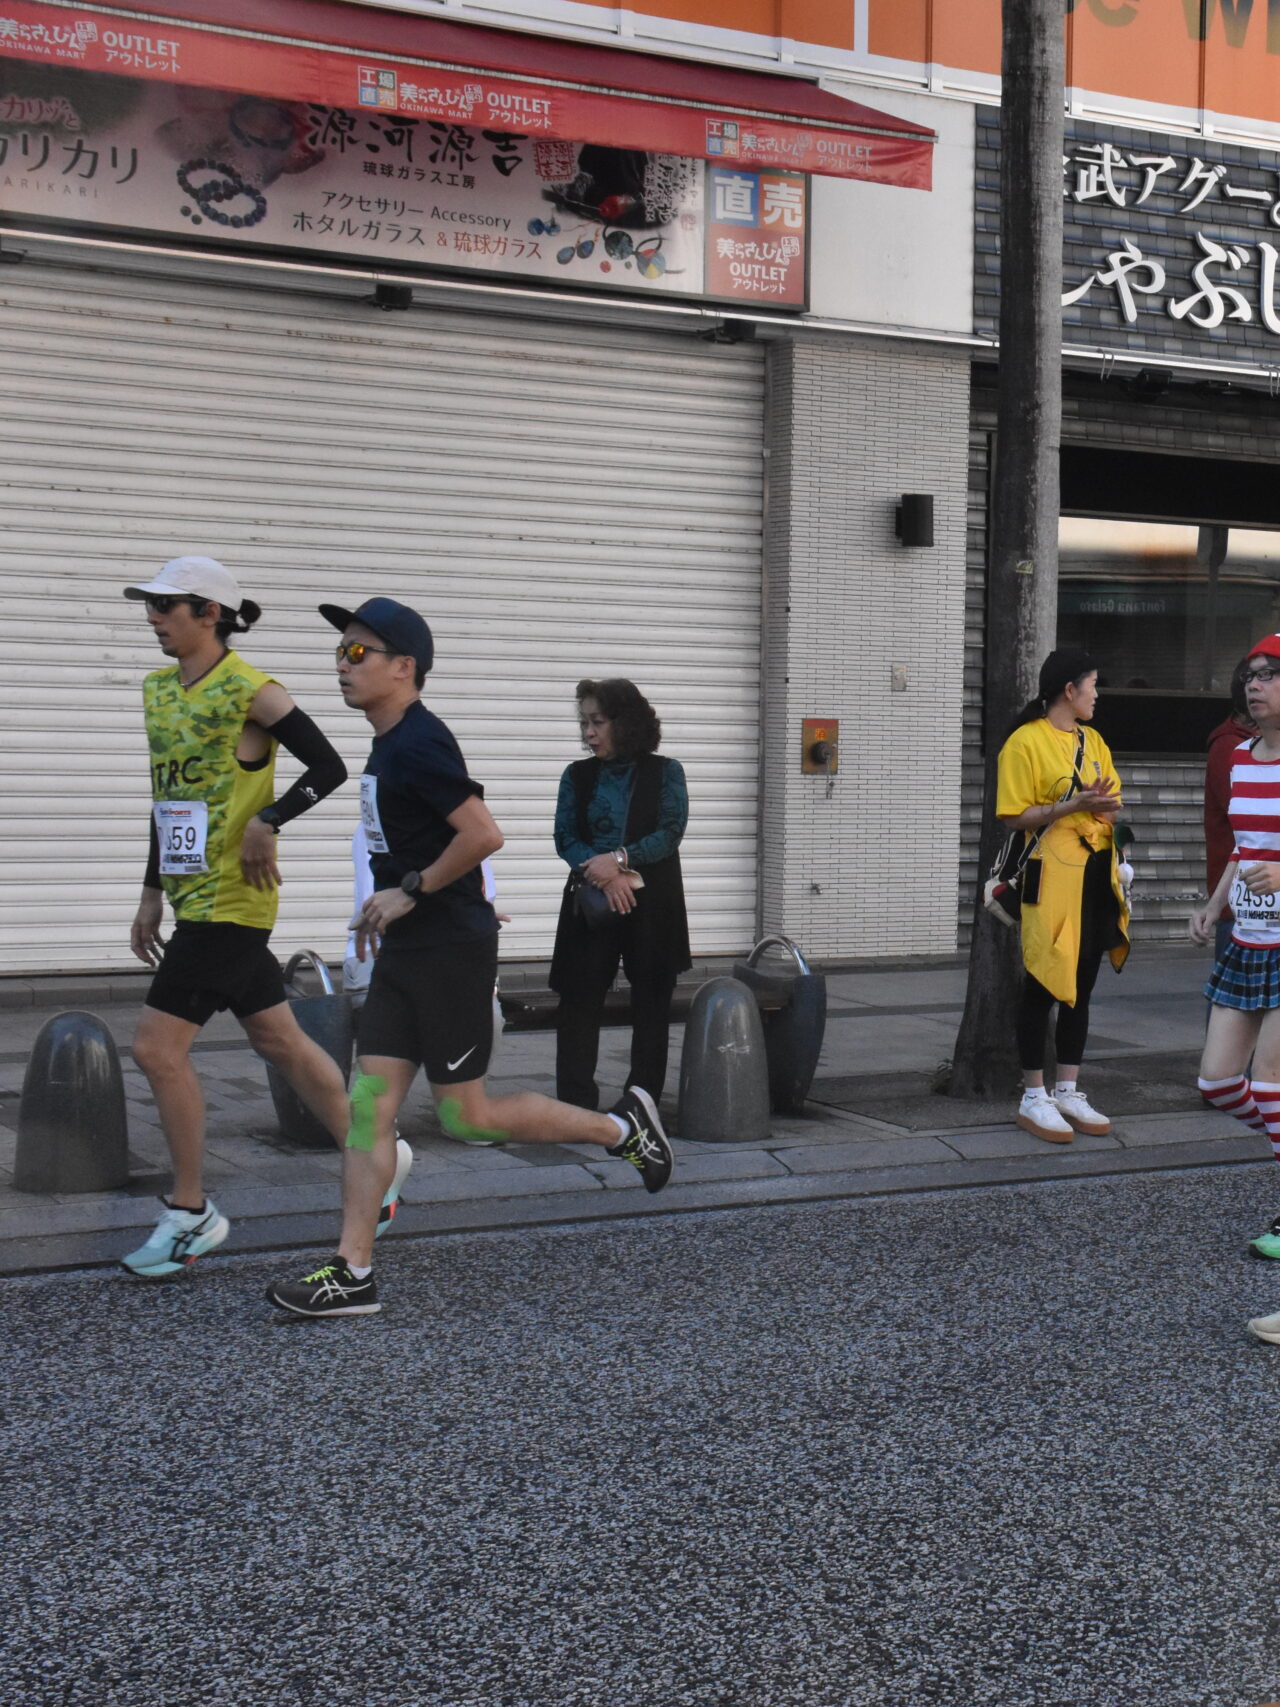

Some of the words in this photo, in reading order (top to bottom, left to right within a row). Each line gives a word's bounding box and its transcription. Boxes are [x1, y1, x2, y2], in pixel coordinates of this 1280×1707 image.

[56, 48, 86, 60] MART
[102, 30, 181, 57] OUTLET
[104, 49, 181, 74] アウトレット
[361, 69, 395, 90] 工場
[360, 86, 395, 108] 直売
[487, 92, 552, 115] OUTLET
[400, 102, 444, 116] OKINAWA
[448, 109, 473, 120] MART
[488, 108, 552, 129] アウトレット
[708, 121, 739, 140] 工場
[816, 139, 872, 159] OUTLET
[363, 161, 476, 189] 琉球ガラス工房
[321, 191, 424, 217] アクセサリー
[431, 206, 511, 230] Accessory
[714, 176, 803, 228] 直売
[293, 211, 425, 246] ホタルガラス
[437, 232, 448, 247] &
[454, 231, 542, 260] 琉球ガラス
[729, 262, 788, 282] OUTLET
[732, 277, 786, 294] アウトレット
